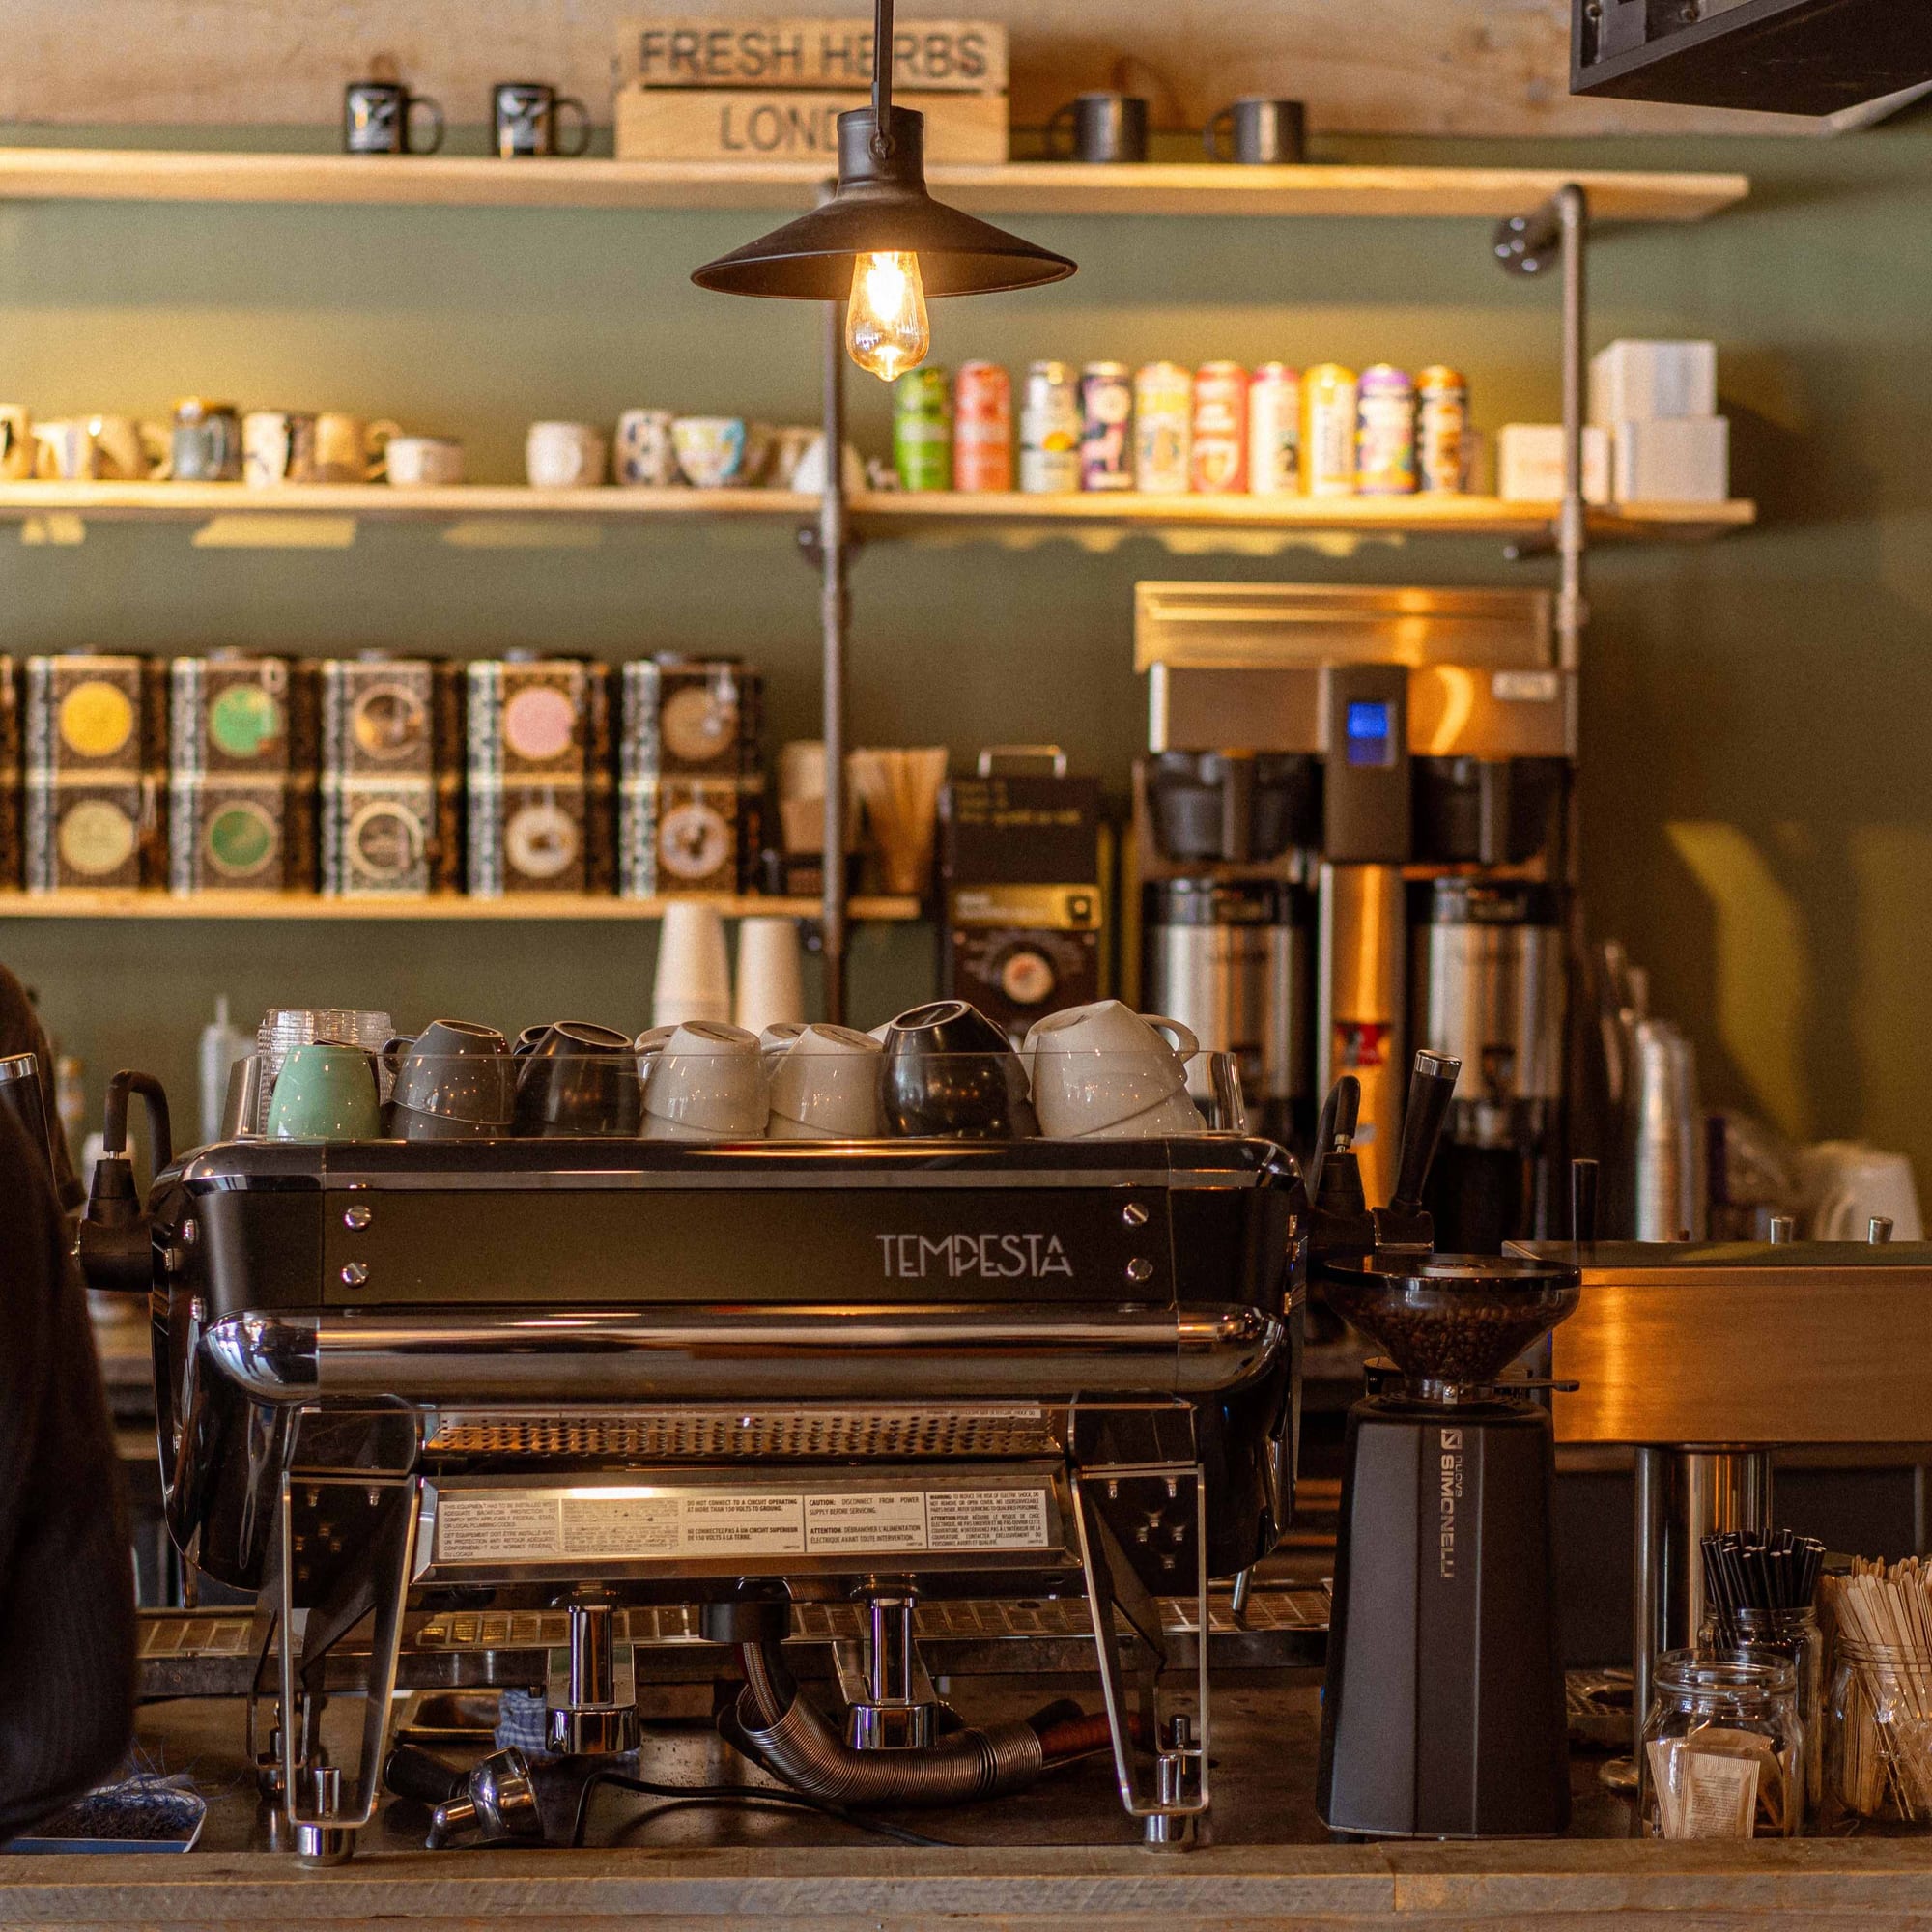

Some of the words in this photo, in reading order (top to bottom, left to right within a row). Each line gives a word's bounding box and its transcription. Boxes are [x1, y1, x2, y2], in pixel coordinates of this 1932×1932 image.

[638, 29, 803, 77] FRESH
[876, 1234, 1074, 1277] TEMPESTA
[1441, 1455, 1454, 1577] SIMONELLI
